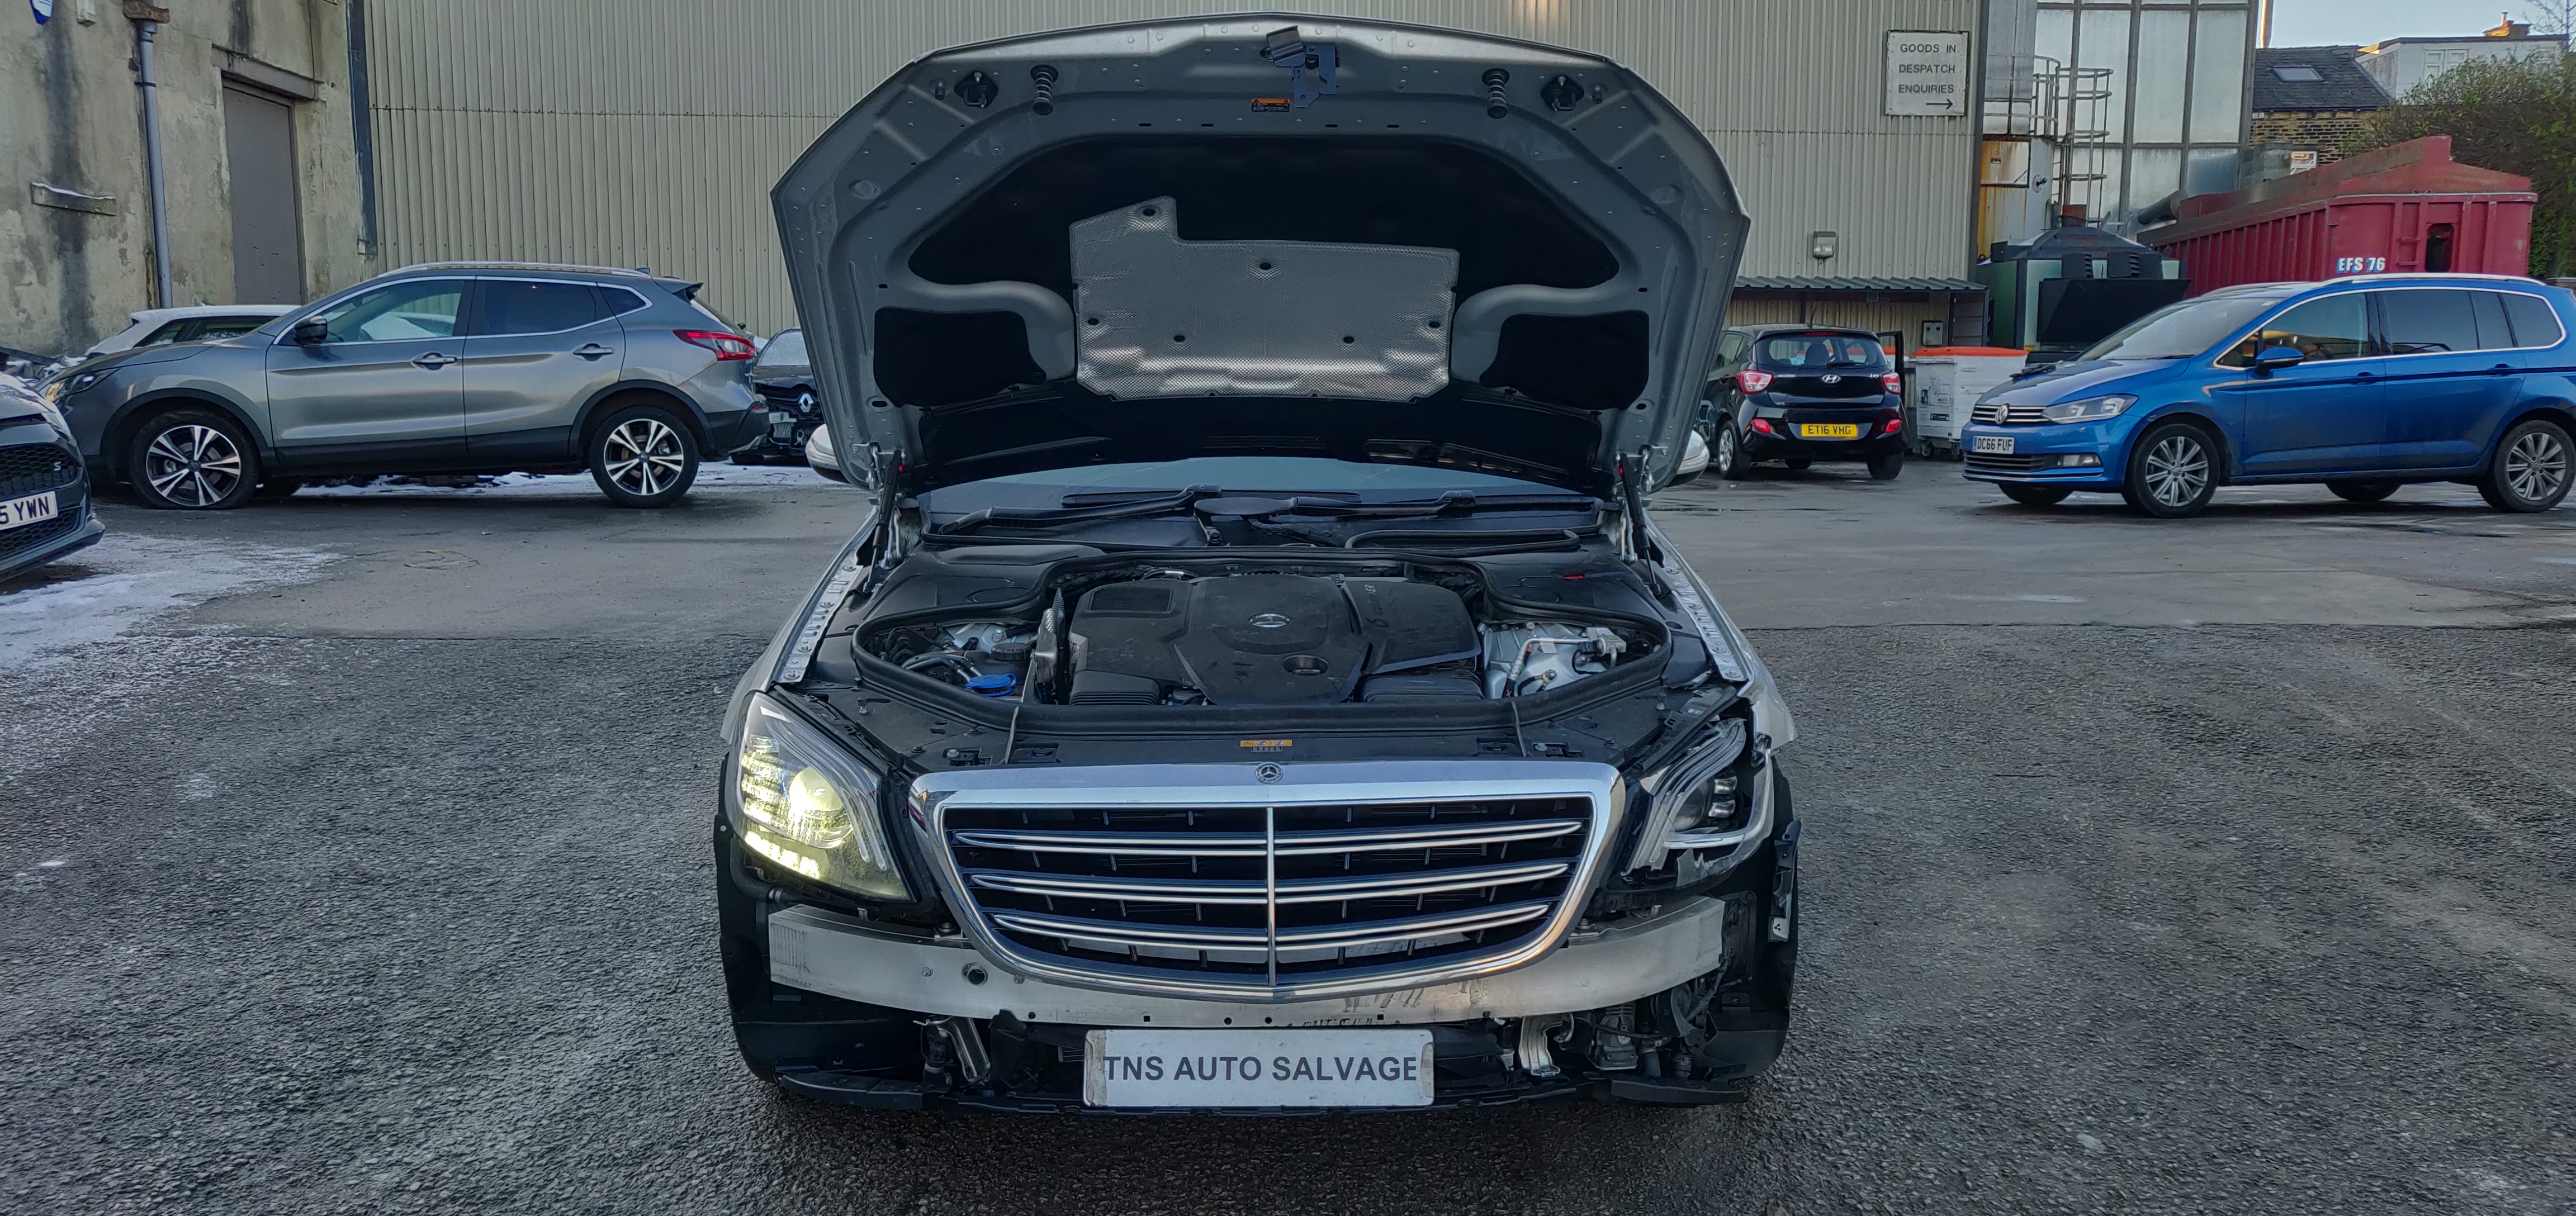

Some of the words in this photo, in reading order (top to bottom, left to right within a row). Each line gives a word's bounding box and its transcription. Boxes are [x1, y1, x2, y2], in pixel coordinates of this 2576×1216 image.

[1900, 44, 1939, 53] GOODS
[1946, 44, 1956, 53] IN
[1899, 64, 1955, 73] DESPATCH
[1898, 84, 1954, 93] ENQUIRIES
[2337, 257, 2364, 273] EFS
[2366, 257, 2386, 273] 76
[1808, 425, 1829, 434] ET16
[1833, 425, 1851, 434] VHG
[1977, 438, 1995, 450] DC66
[14, 496, 50, 521] YWN
[1103, 1056, 1164, 1081] TNS
[1173, 1056, 1262, 1081] AUTO
[1272, 1056, 1417, 1081] SALVAGE
